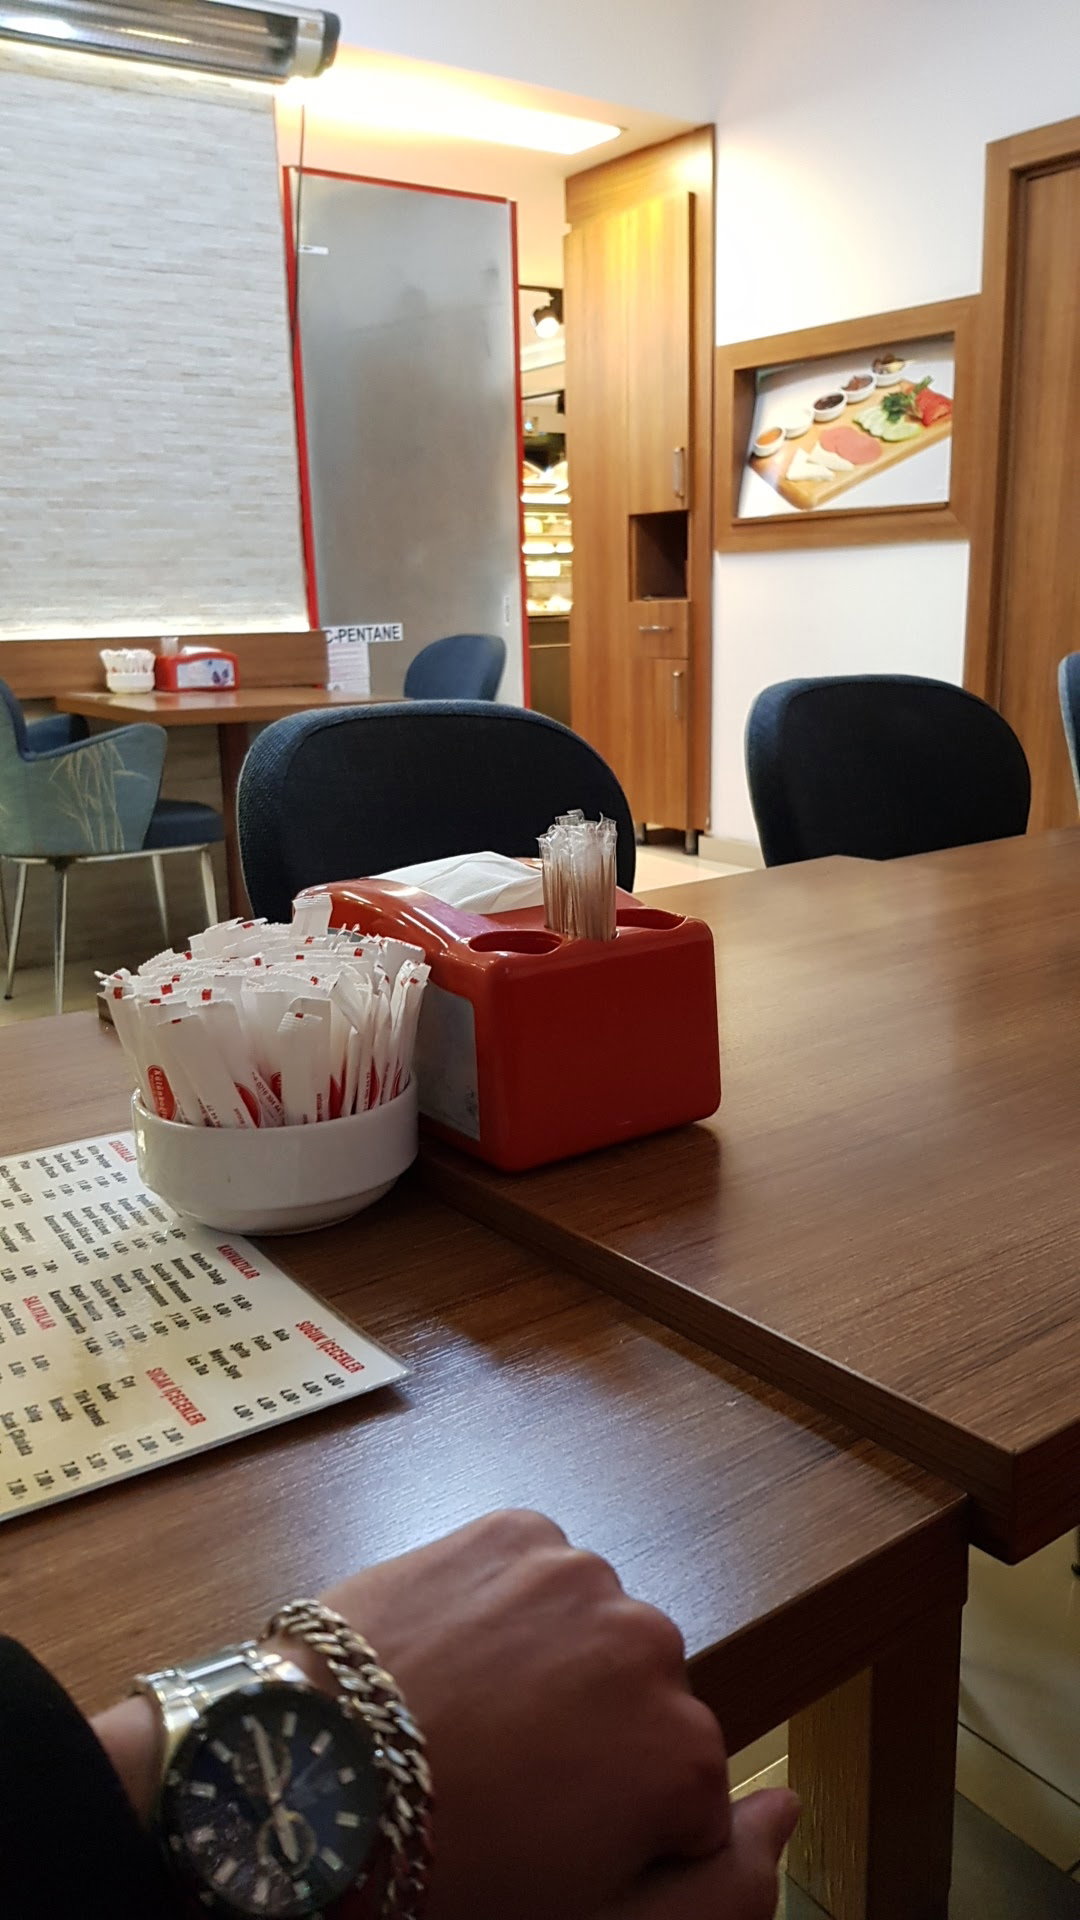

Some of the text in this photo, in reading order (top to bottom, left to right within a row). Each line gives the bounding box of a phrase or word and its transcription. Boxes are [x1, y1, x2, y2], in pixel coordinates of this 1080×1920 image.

[42, 1260, 58, 1271] 7.00
[111, 1274, 132, 1293] Yumurta
[171, 1258, 195, 1279] Menemen
[190, 1252, 252, 1309] Kahvaltı Tabağı 16.00
[216, 1244, 260, 1279] KAHVALTILAR
[22, 1296, 56, 1330] SALATALAR
[90, 1279, 147, 1340] Sucuklu Yumurta 11.00
[151, 1263, 211, 1321] Sucuklu Menemen 11.00
[169, 1313, 190, 1327] 11.00
[105, 1331, 125, 1347] 11.00
[251, 1335, 322, 1394] Fanta 4.00
[273, 1329, 344, 1386] Kola 4.00
[295, 1321, 364, 1373] SOĞUK İÇECEKLER
[74, 1390, 92, 1405] Türk
[146, 1367, 206, 1426] SICAK İÇECEKLER
[194, 1364, 209, 1375] Tea
[233, 1405, 253, 1418] 4.00
[208, 1349, 277, 1410] Meyve Suyu 4.00
[230, 1342, 300, 1402] Sprite 4.00
[49, 1397, 107, 1469] Nescafe 5.00
[82, 1403, 109, 1426] Kahvesi
[97, 1383, 159, 1451] Oralet 2.00
[118, 1376, 184, 1442] Çay 2.00
[5, 1429, 33, 1456] Çikolata
[34, 1470, 55, 1486] 7.00
[24, 1405, 81, 1478] Salep 7.00
[7, 1478, 28, 1495] 7.00
